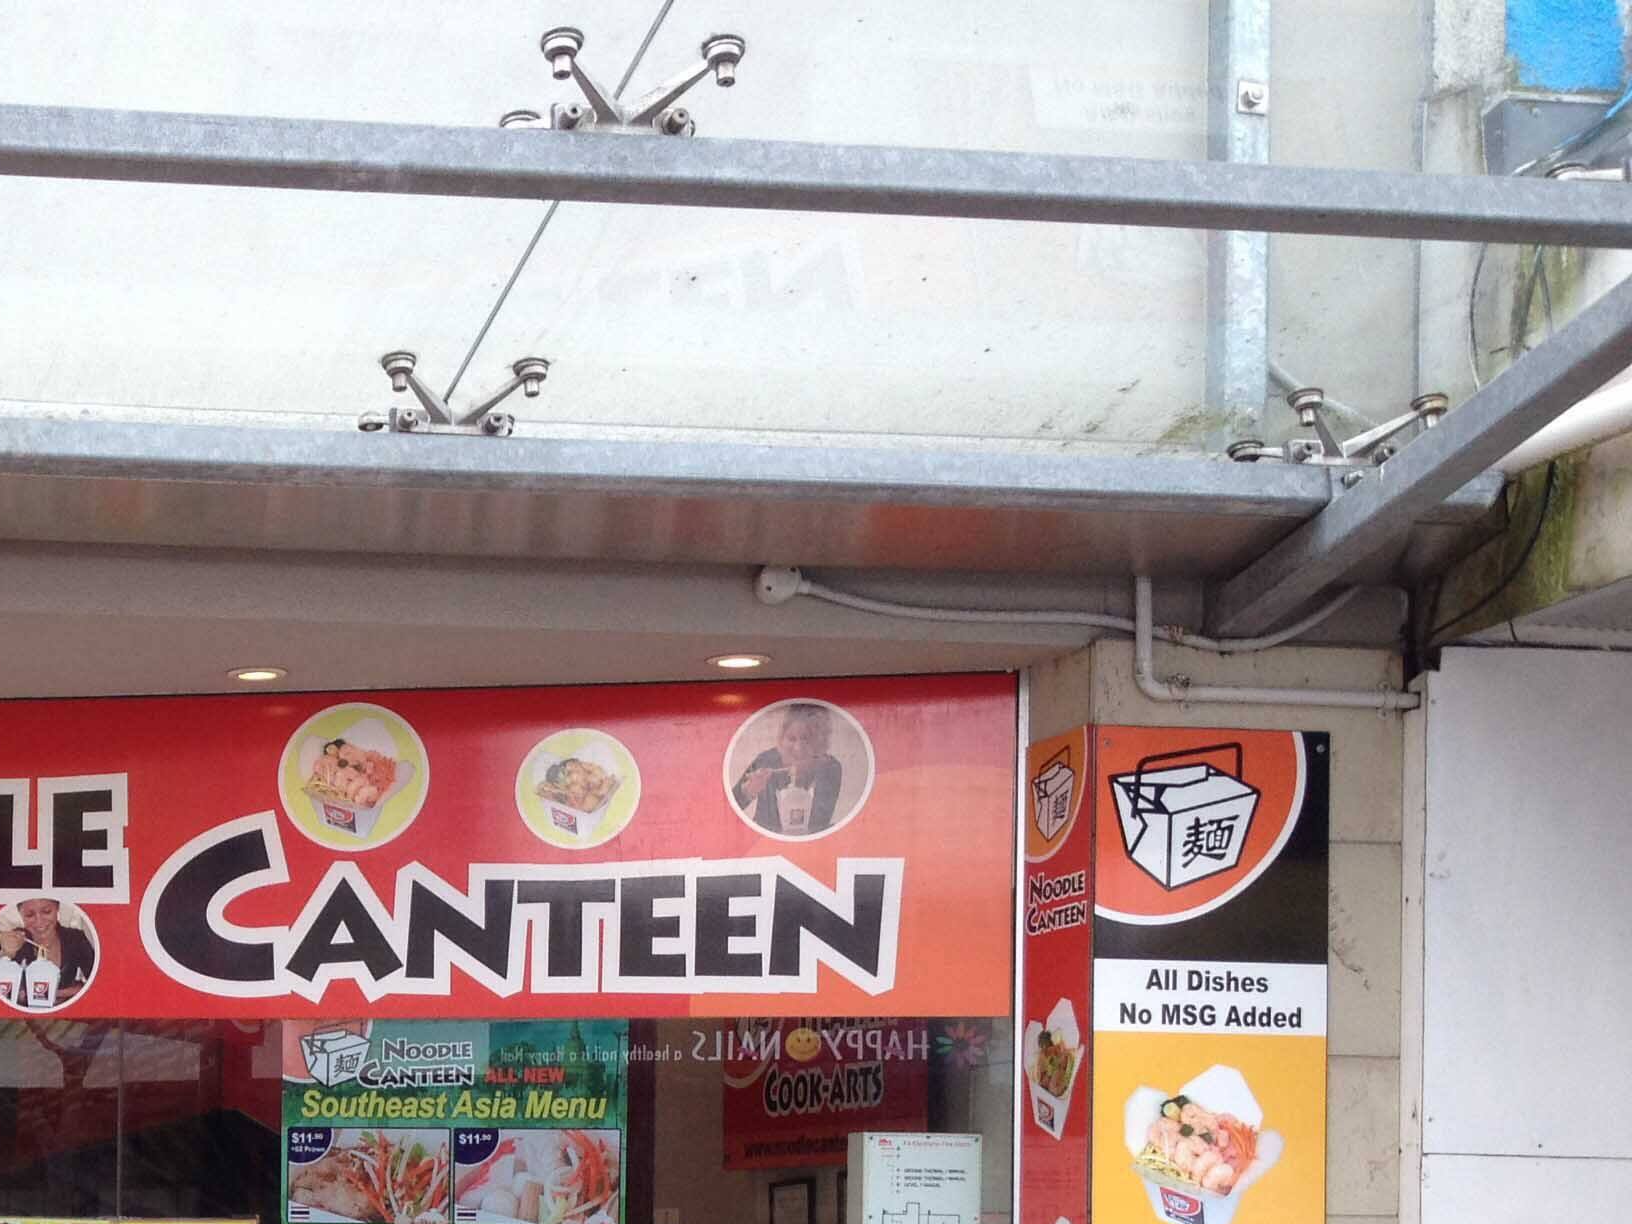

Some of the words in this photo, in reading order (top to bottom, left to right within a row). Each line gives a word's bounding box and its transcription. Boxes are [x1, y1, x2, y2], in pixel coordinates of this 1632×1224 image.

[1028, 870, 1086, 906] NOODLE
[139, 810, 905, 1003] CANTEEN
[1025, 900, 1088, 936] CANTEEN
[1145, 968, 1178, 991] All
[1187, 970, 1269, 993] Dishes
[1119, 1002, 1152, 1026] No
[1161, 1004, 1217, 1027] MSG
[1225, 1006, 1303, 1029] Added
[381, 1037, 474, 1064] NOODLE
[356, 1059, 475, 1090] CANTEEN
[484, 1066, 517, 1084] ALL
[522, 1066, 568, 1085] NEW
[764, 1063, 884, 1117] COOK-ARTS
[300, 1090, 449, 1120] Southeast
[451, 1090, 517, 1120] Asia
[524, 1091, 608, 1120] Menu
